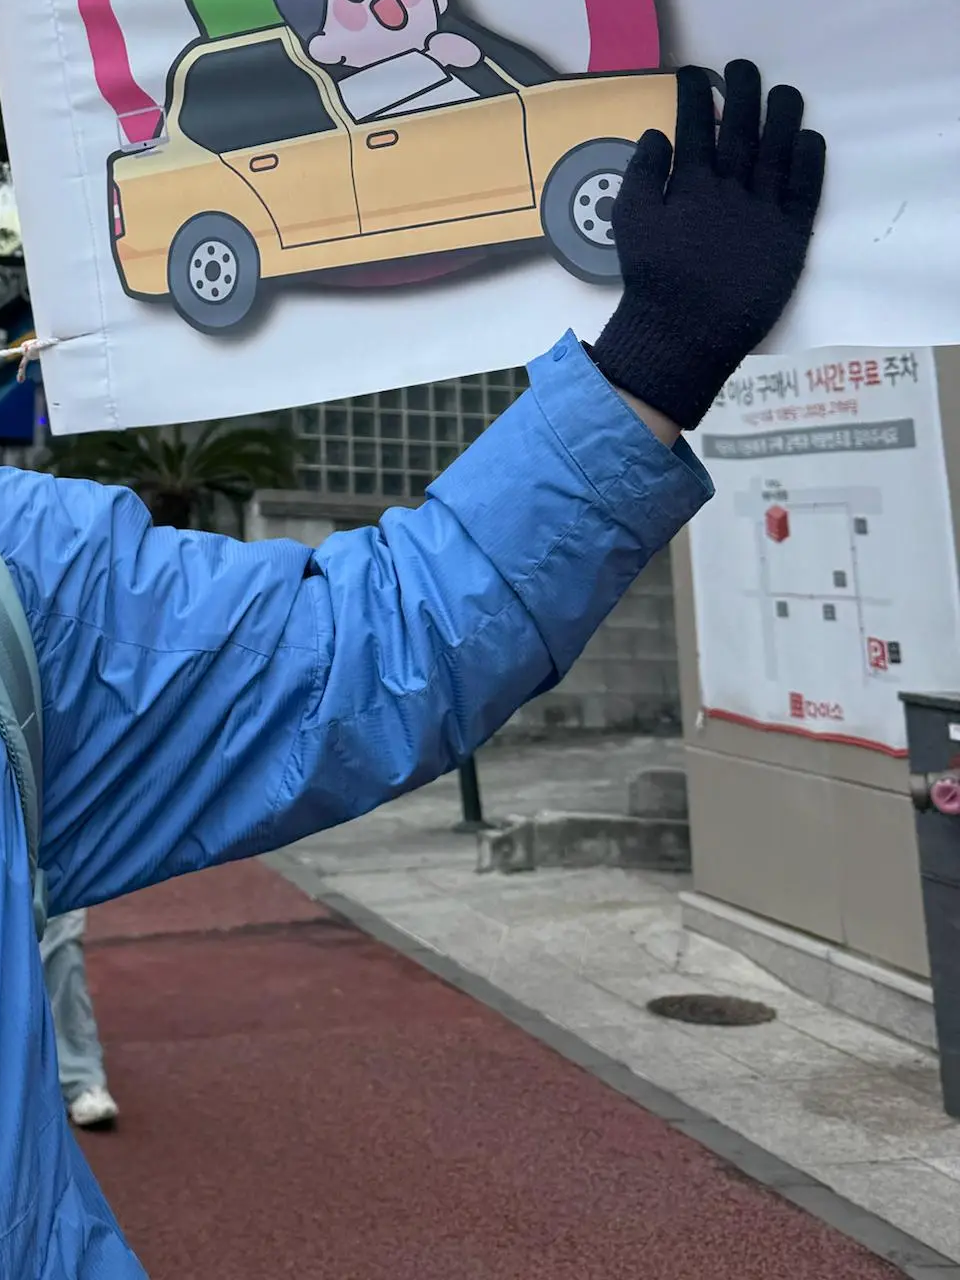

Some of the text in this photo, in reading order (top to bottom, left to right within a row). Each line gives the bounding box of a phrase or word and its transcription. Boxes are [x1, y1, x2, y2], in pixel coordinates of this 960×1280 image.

[806, 363, 845, 392] 1시간
[848, 360, 881, 389] 무료
[884, 353, 918, 386] 주차
